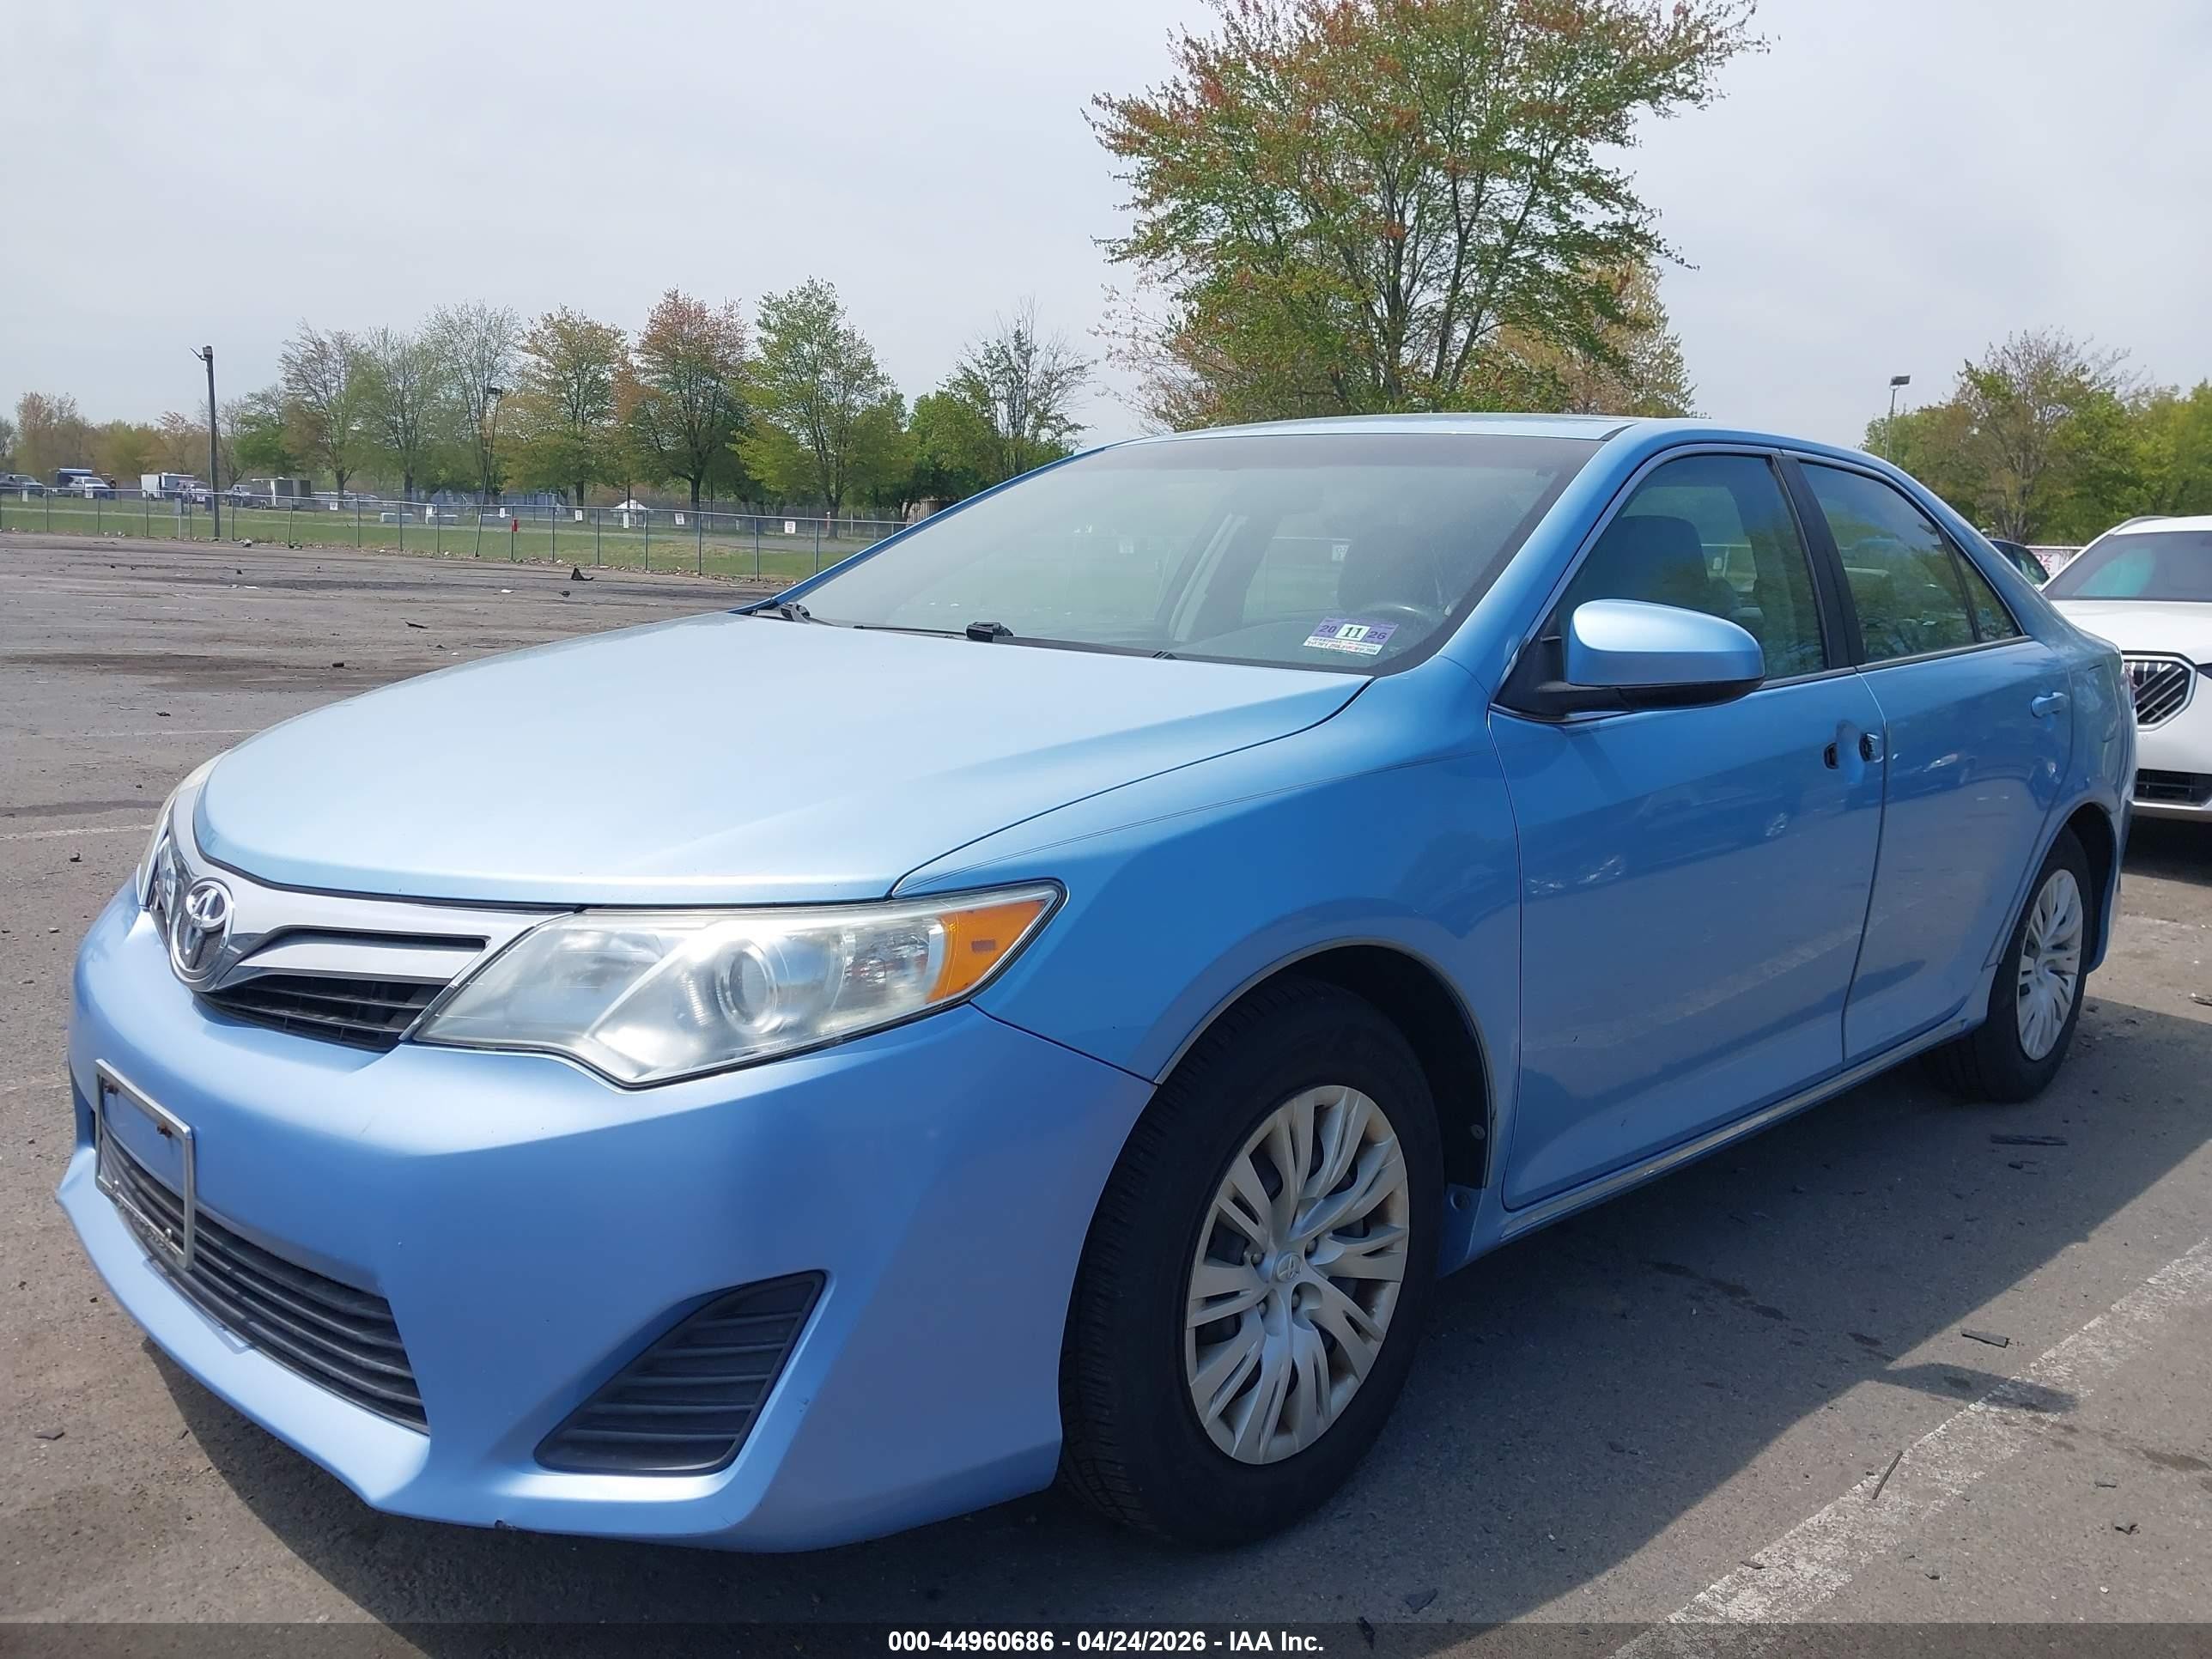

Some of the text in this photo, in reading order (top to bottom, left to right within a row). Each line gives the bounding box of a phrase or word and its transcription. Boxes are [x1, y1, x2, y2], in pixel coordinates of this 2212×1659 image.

[1319, 625, 1388, 640] 20 11 26
